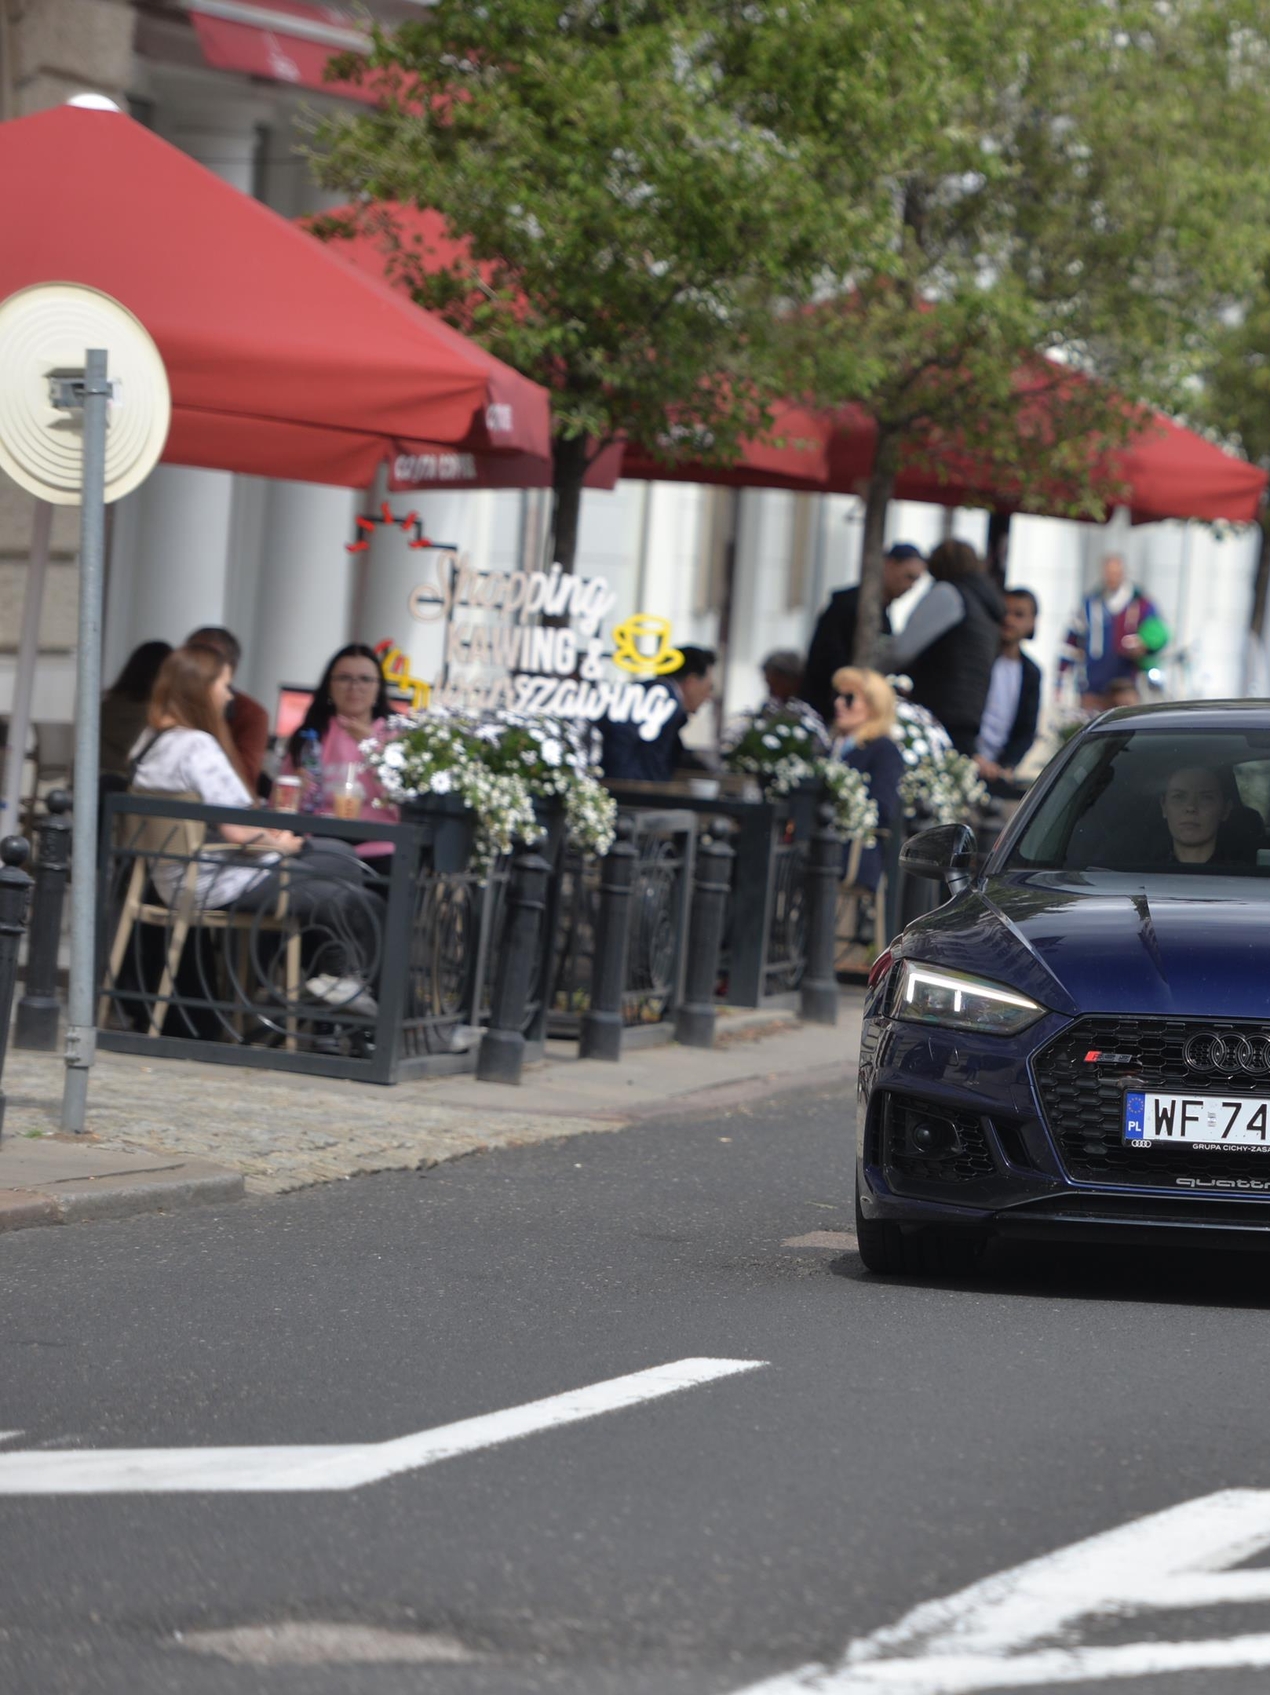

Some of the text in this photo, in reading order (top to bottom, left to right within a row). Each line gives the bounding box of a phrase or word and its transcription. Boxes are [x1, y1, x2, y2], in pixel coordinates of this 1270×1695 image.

[448, 620, 577, 675] KAWING
[1128, 1120, 1142, 1132] PL
[1154, 1098, 1204, 1137] WF
[1192, 1143, 1222, 1151] GRUPA
